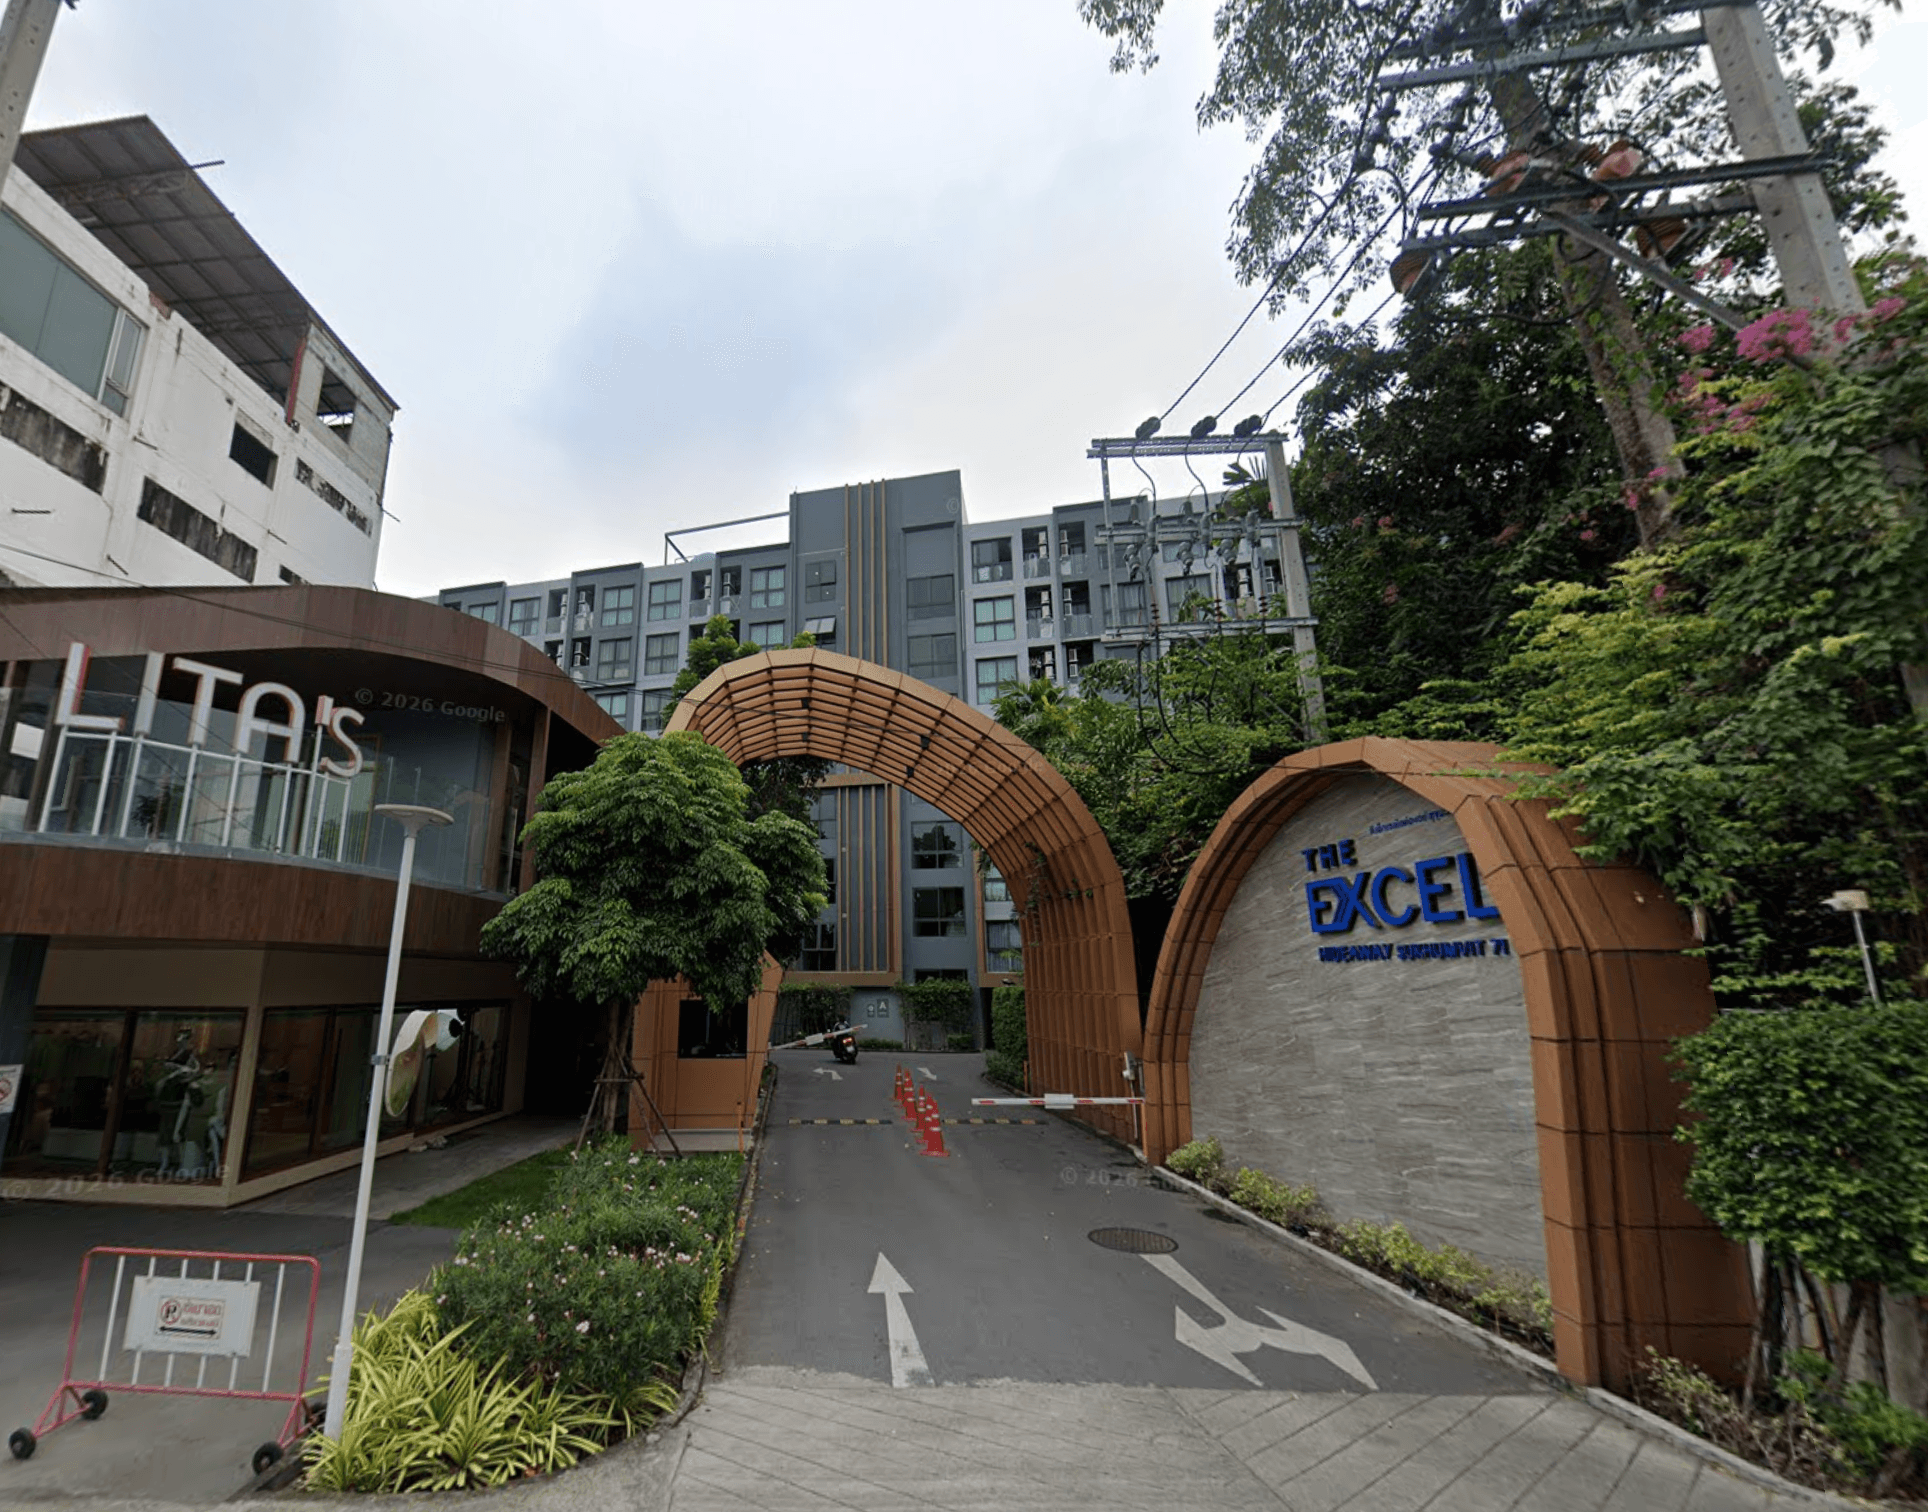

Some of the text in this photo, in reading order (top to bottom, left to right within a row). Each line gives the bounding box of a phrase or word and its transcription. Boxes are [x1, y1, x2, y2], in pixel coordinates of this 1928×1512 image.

[1302, 838, 1358, 872] THE
[1306, 852, 1499, 934] EXCEL
[1318, 943, 1394, 963] HIDEAWAY
[1396, 939, 1486, 961] SUKHUMVIT
